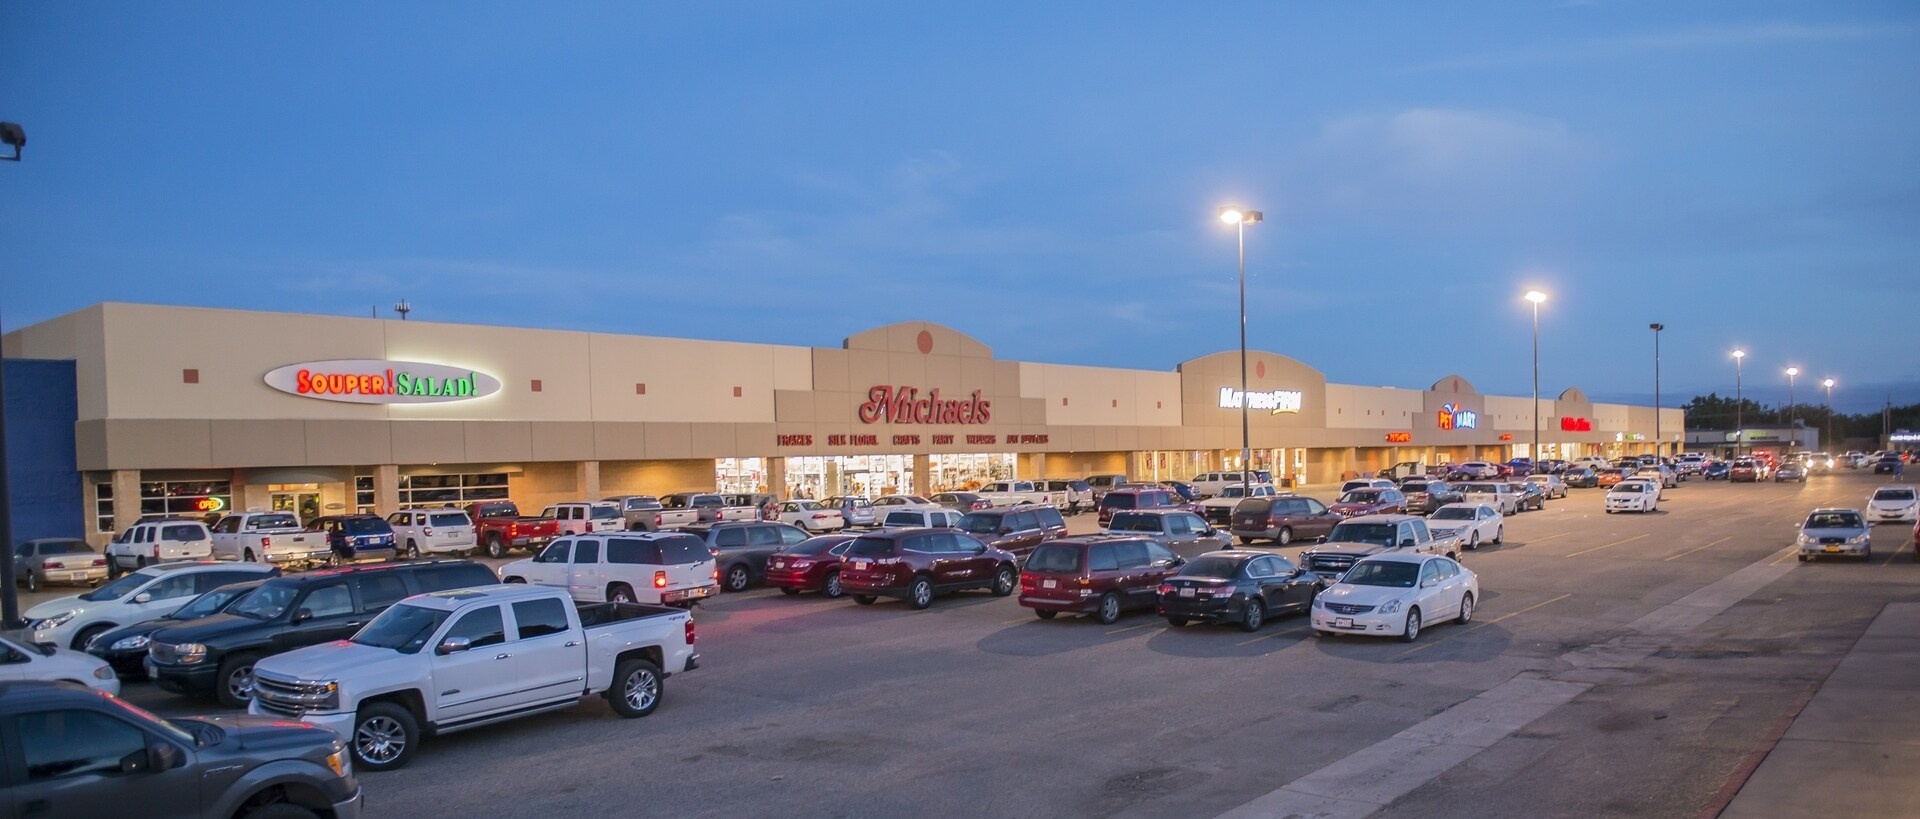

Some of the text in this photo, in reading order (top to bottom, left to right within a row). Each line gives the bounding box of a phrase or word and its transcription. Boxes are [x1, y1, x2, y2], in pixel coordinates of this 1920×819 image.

[859, 385, 991, 424] Michaels
[827, 434, 879, 446] SILK FLORAL
[892, 434, 920, 446] CRAFTS
[932, 434, 954, 445] PARTY
